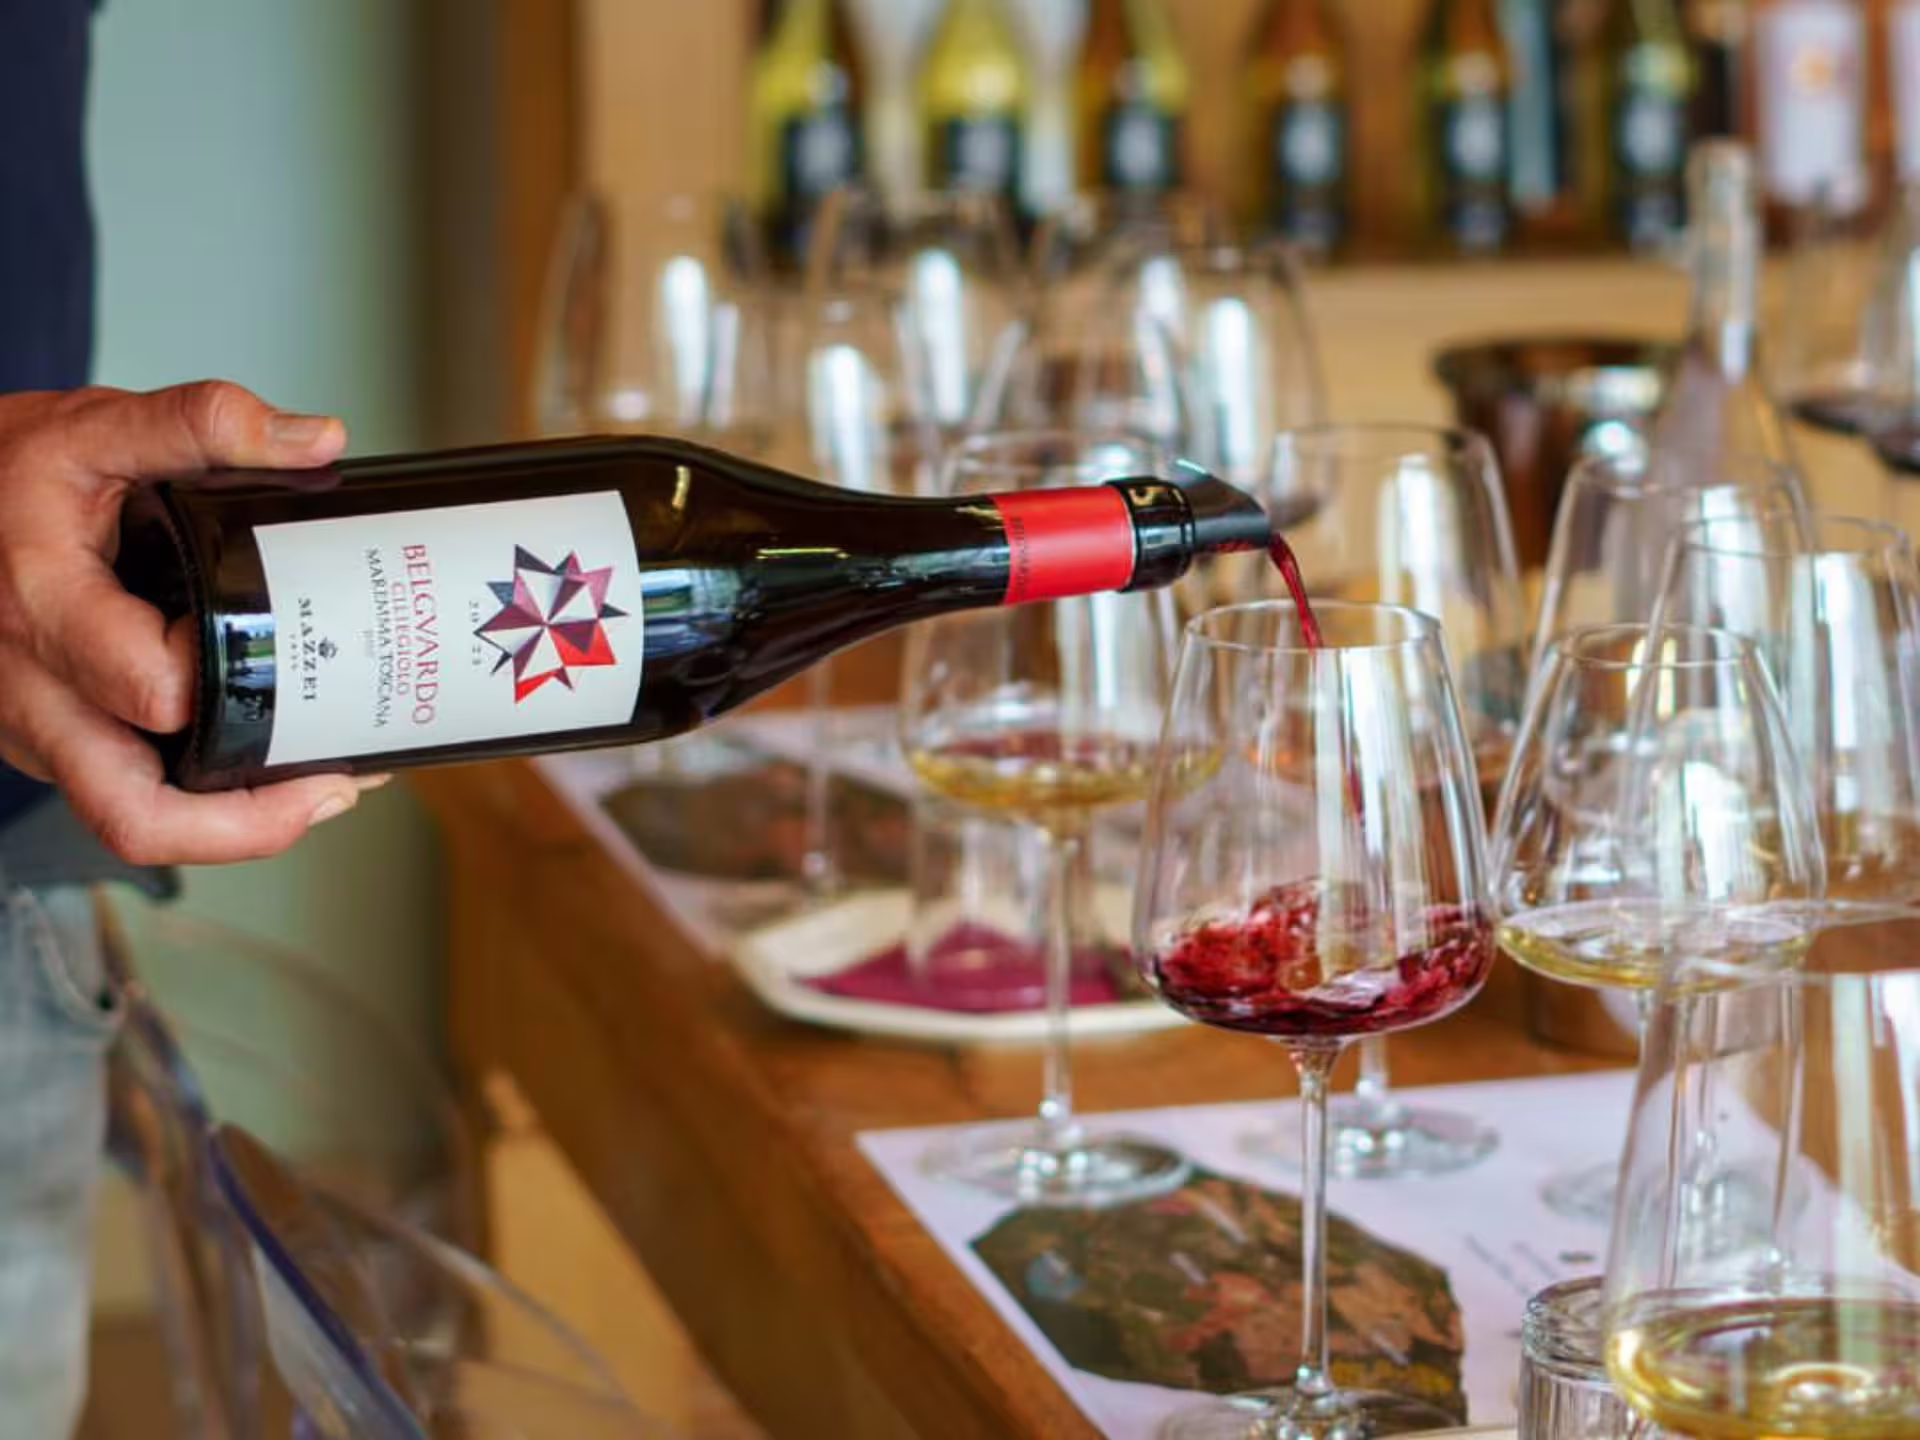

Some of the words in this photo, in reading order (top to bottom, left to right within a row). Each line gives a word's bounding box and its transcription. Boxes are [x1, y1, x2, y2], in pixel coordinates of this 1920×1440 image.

[366, 547, 393, 648] MAREMMA
[402, 544, 439, 725] BELGVARDO
[298, 597, 317, 701] MAZZEI
[373, 651, 395, 729] TOSCANA
